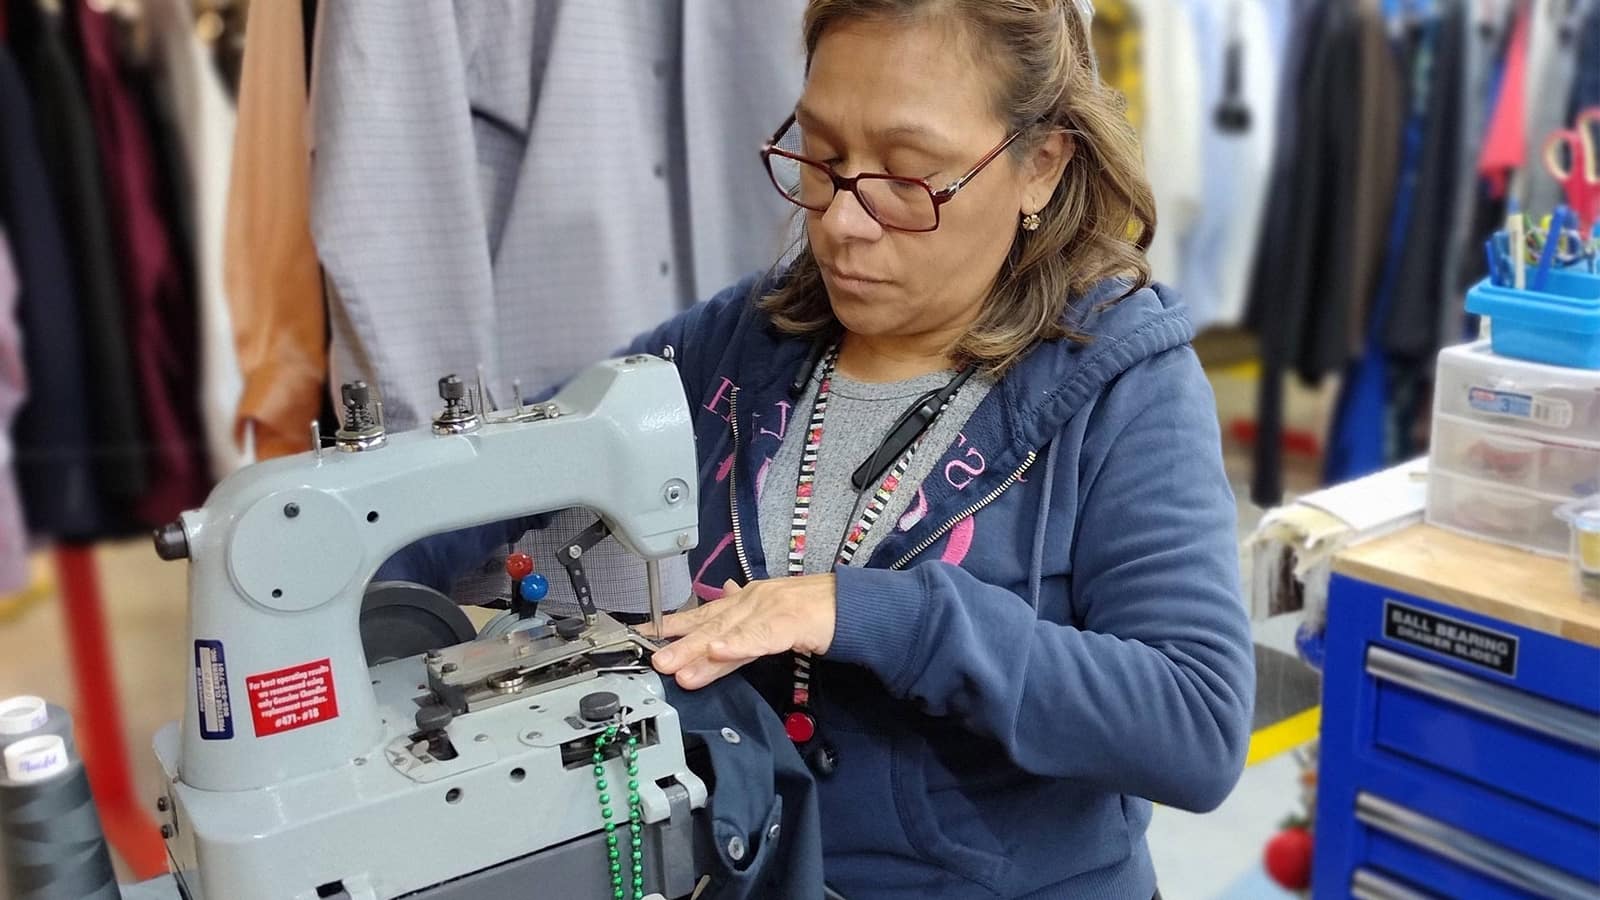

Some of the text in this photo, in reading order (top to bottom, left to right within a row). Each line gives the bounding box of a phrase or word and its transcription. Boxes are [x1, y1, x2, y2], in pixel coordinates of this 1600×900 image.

[1391, 610, 1509, 655] BALL BEARING
[1396, 625, 1501, 666] DRAWER SLIDES
[248, 665, 329, 691] For best operating results
[269, 680, 306, 696] recommend
[306, 677, 324, 687] using
[257, 685, 327, 709] only Genuine Chandler
[261, 702, 301, 718] replacement
